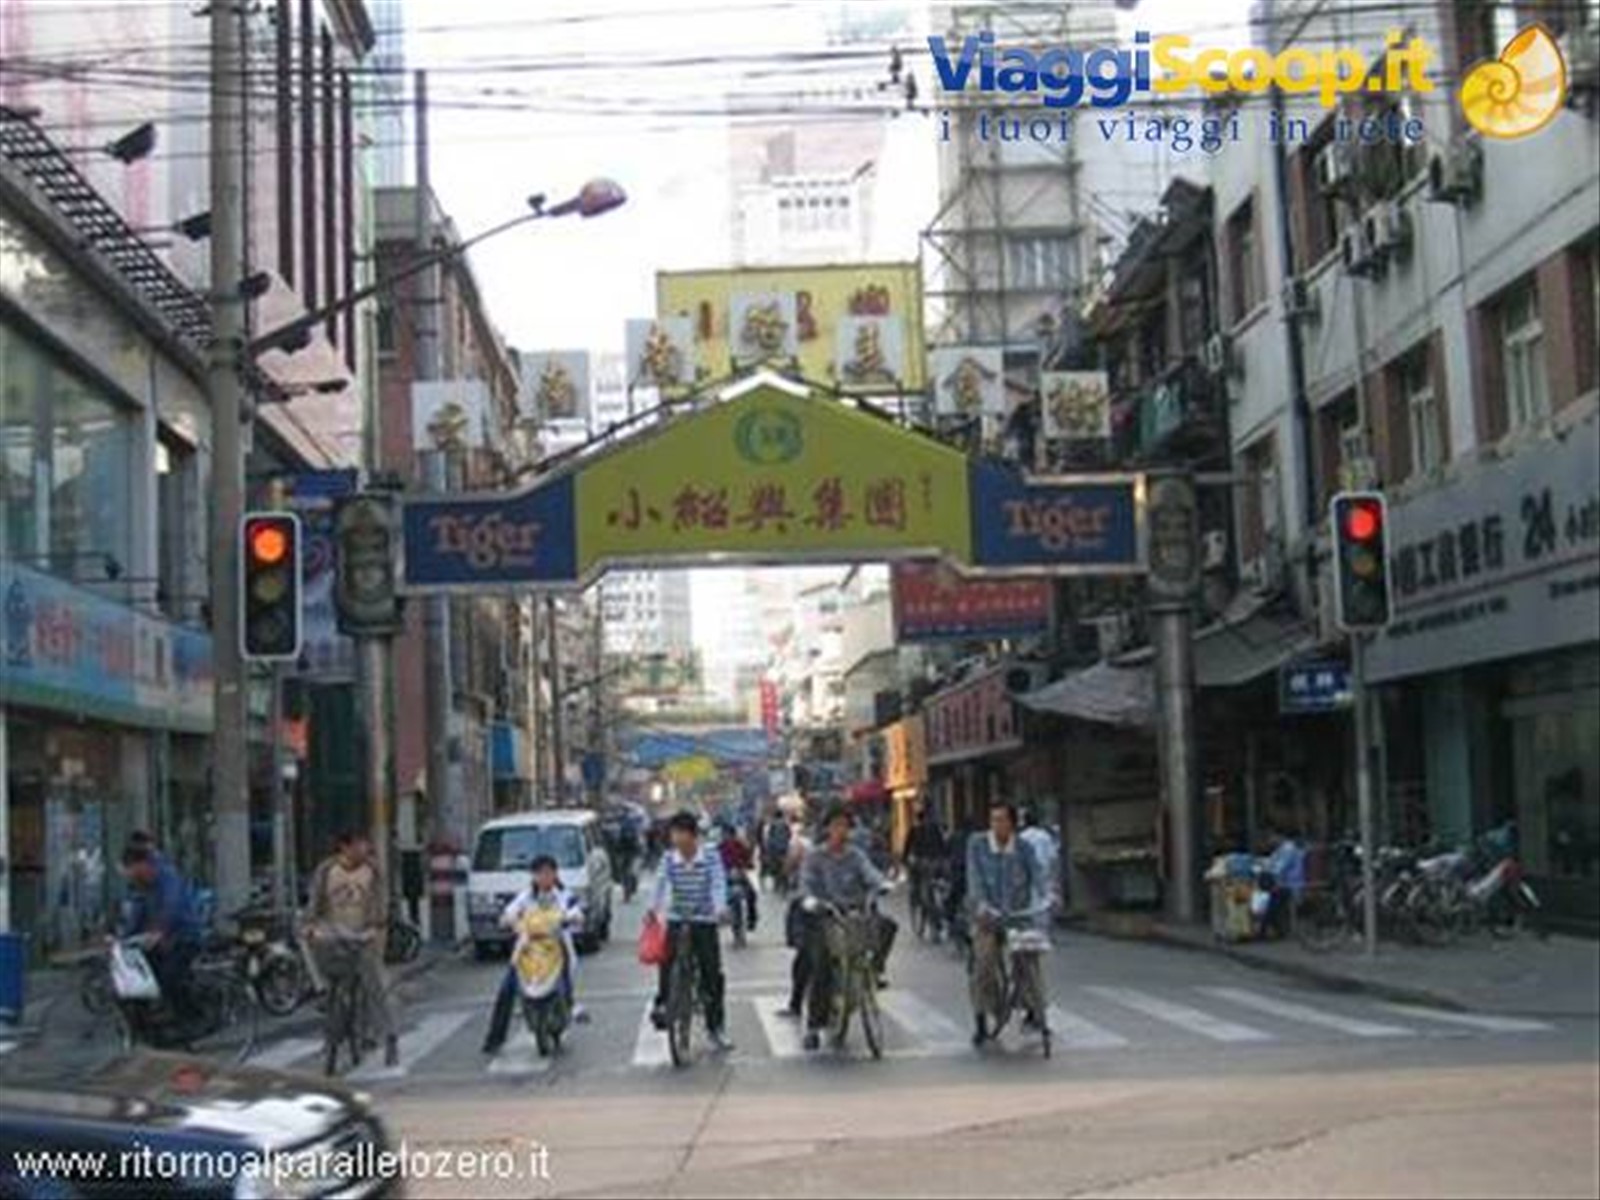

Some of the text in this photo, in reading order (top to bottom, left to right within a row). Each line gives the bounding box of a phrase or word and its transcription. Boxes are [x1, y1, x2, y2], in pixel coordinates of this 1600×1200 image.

[429, 512, 541, 569] Tiger
[1003, 496, 1111, 550] Tiger
[1521, 487, 1556, 560] 24
